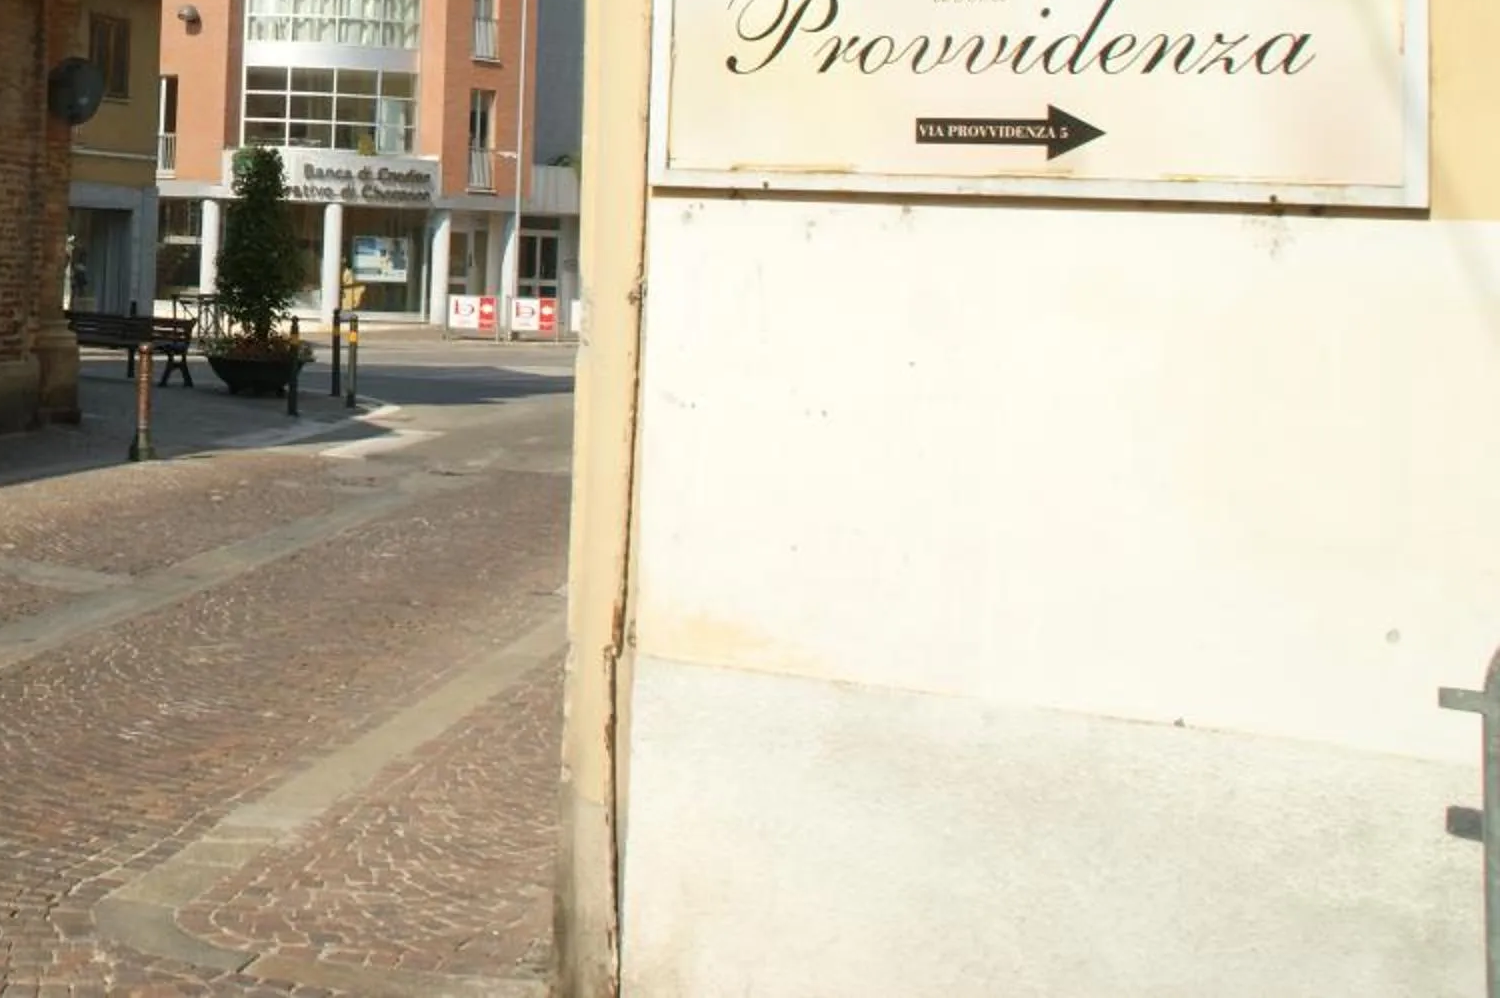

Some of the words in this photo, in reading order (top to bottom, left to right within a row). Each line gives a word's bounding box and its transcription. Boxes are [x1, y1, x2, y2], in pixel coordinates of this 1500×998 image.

[918, 123, 946, 138] VIA
[947, 124, 1057, 140] PROVVIDENZA
[1059, 126, 1070, 140] 5
[303, 162, 353, 181] Banca
